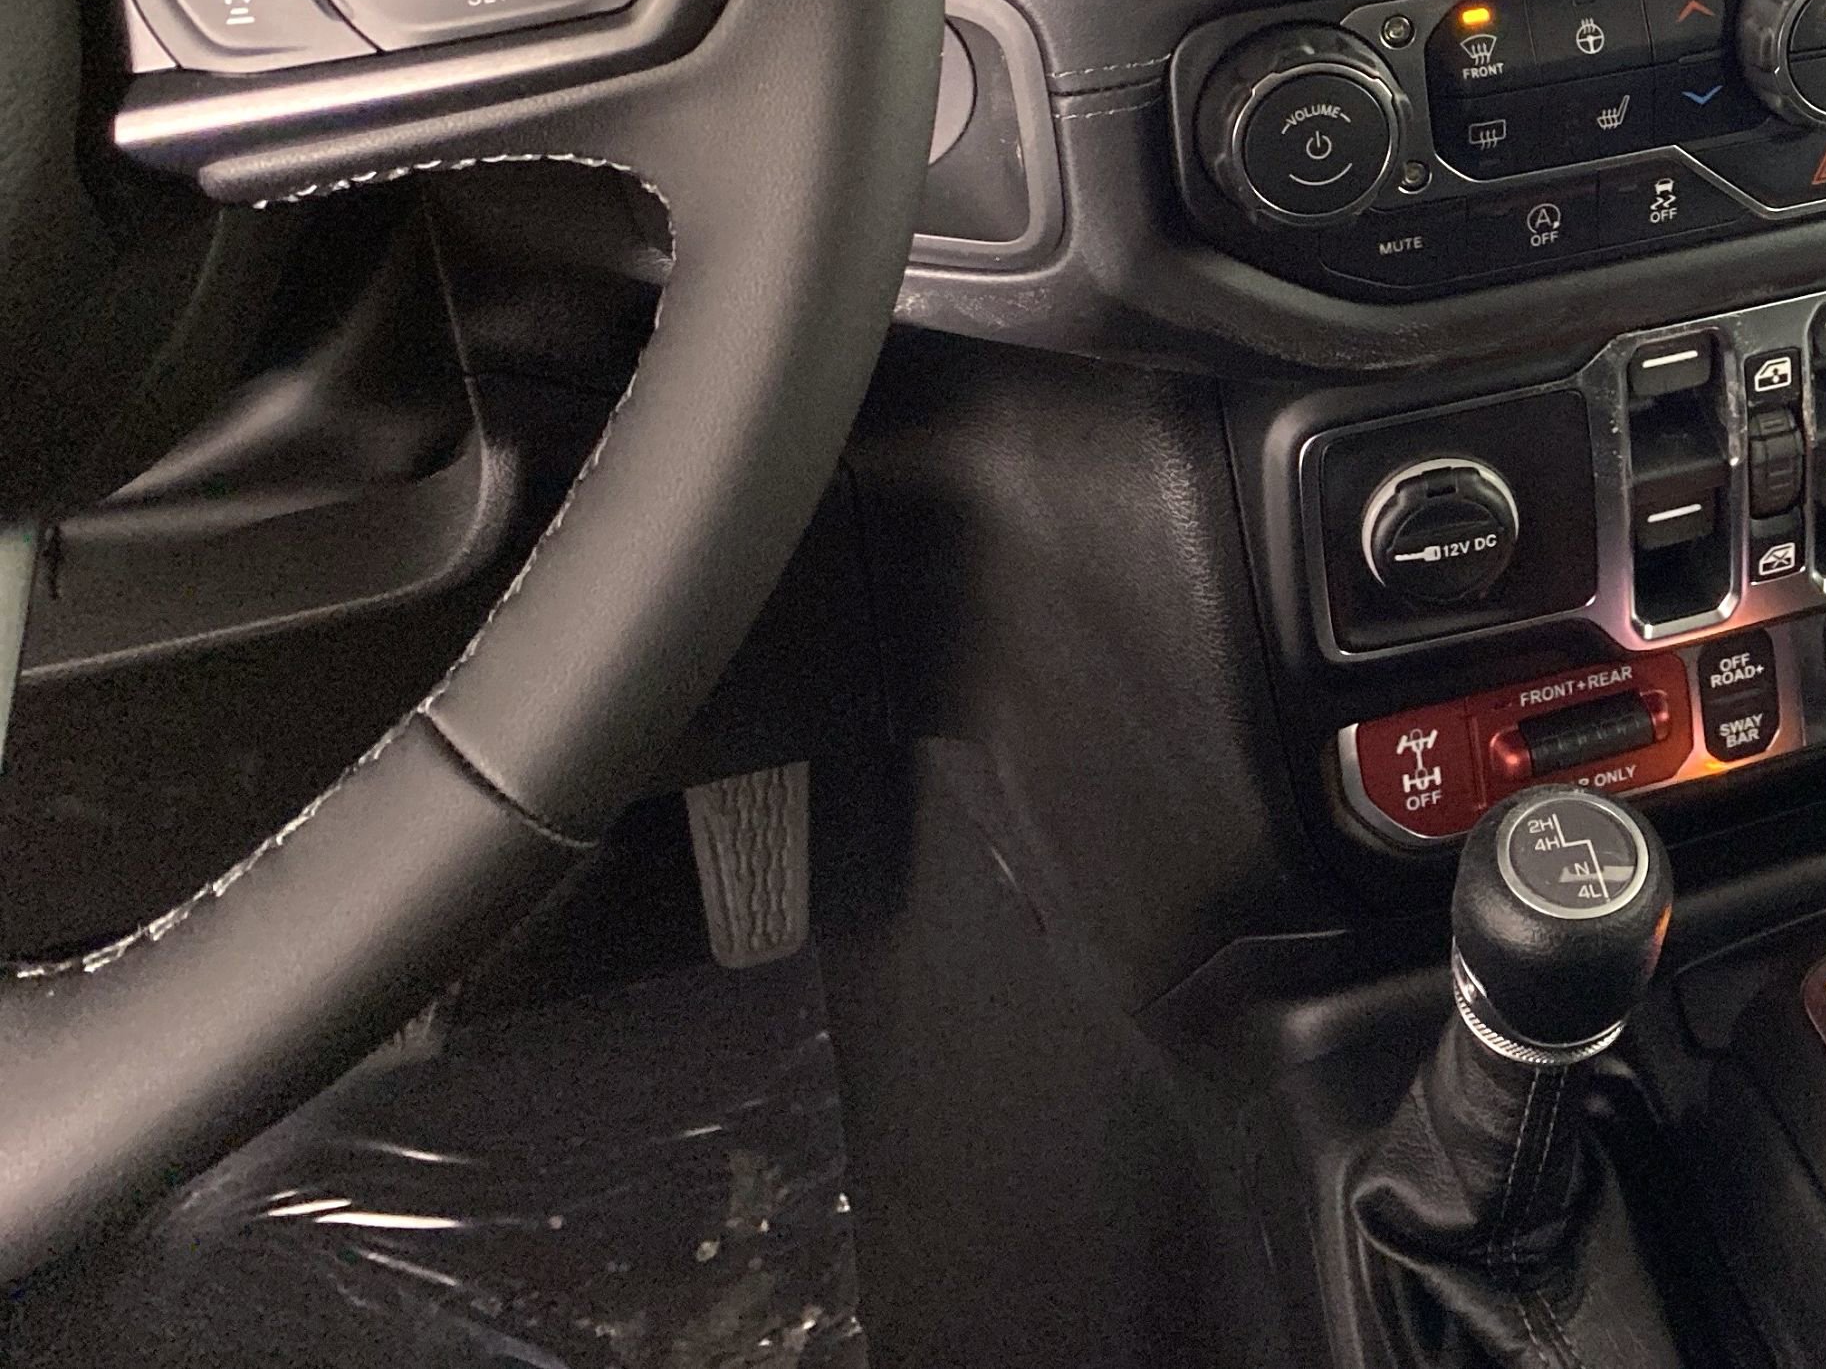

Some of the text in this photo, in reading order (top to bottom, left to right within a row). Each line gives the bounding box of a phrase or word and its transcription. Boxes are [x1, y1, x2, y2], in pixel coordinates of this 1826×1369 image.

[1461, 62, 1504, 80] FRONT
[1285, 103, 1342, 126] VOLUME
[1650, 207, 1678, 224] OFF
[1379, 235, 1424, 256] MUTE
[1530, 230, 1560, 247] OFF
[1443, 533, 1497, 557] 12V DC
[1719, 651, 1751, 672] OFF
[1519, 664, 1634, 708] FRONT+REAR
[1710, 663, 1765, 689] ROAD+
[1719, 712, 1763, 737] SWAY
[1726, 727, 1760, 749] BAR
[1593, 764, 1637, 787] ONLY
[1406, 789, 1443, 812] OFF
[1527, 816, 1554, 834] 2H
[1534, 835, 1560, 852] 4H
[1574, 860, 1590, 877] N
[1577, 883, 1602, 899] 4L
